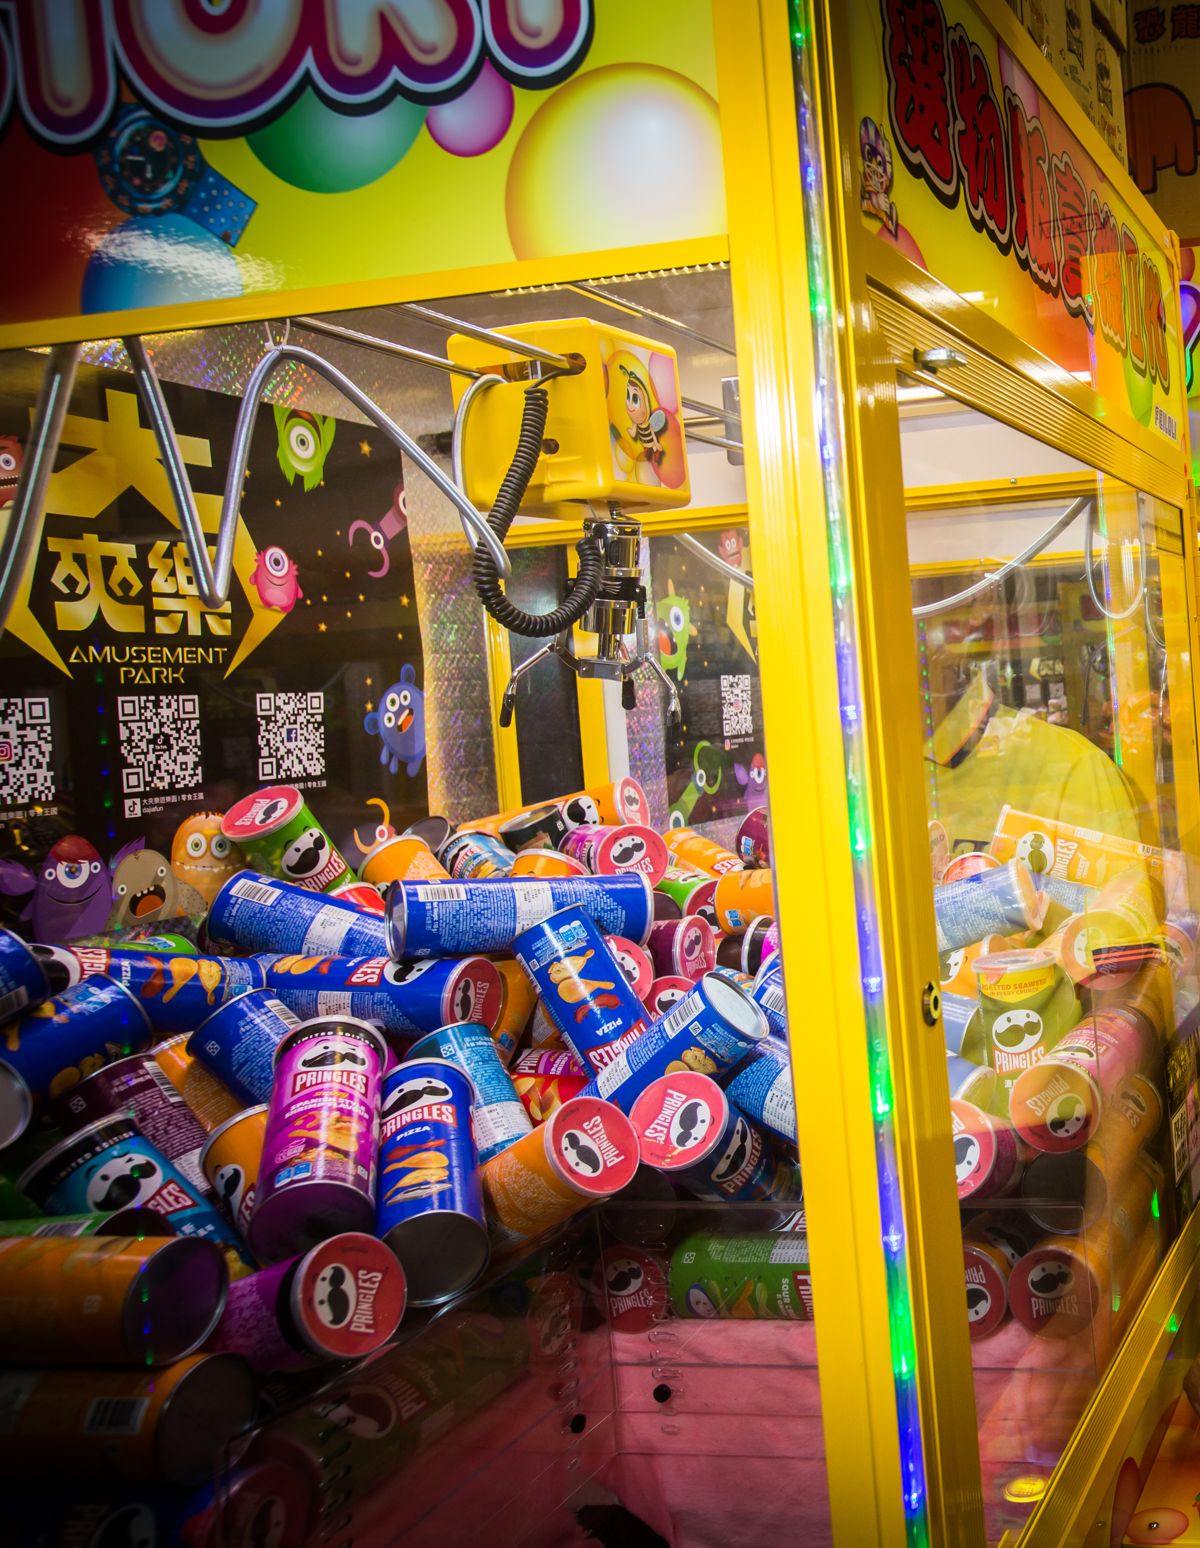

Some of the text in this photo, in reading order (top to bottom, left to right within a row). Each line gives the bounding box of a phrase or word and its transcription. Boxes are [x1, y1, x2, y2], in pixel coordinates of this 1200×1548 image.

[69, 645, 227, 664] AMUSEMENT
[120, 667, 185, 684] PARK
[595, 1017, 623, 1037] PIZZA
[295, 1072, 367, 1094] PRINGLES
[1026, 1073, 1071, 1117] PRINGLES
[644, 1089, 687, 1143] PRINGLES
[396, 1125, 431, 1141] PIZZA
[582, 1115, 625, 1168] PRINGLES
[723, 1129, 763, 1193] PRINGLES
[349, 1269, 383, 1333] PRINGLES
[610, 1289, 654, 1317] PRINGLES
[1032, 1295, 1080, 1319] PRINGLES
